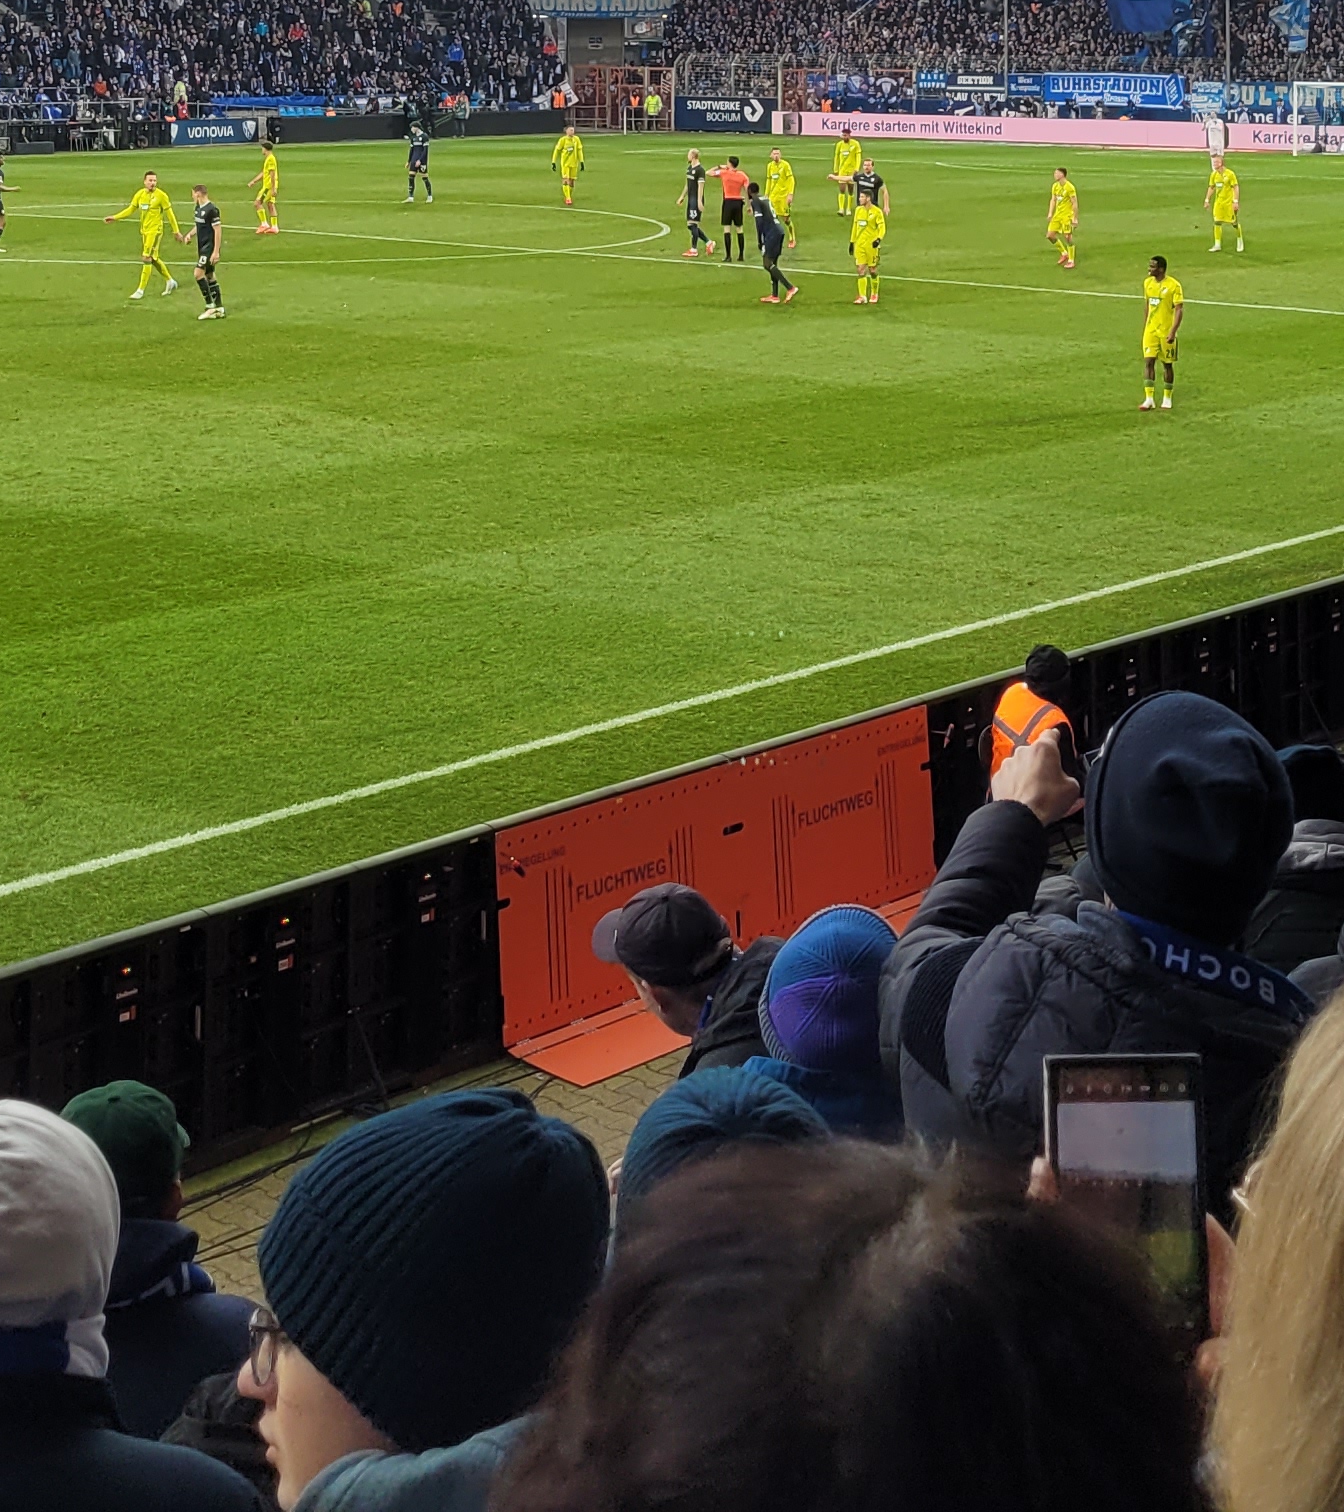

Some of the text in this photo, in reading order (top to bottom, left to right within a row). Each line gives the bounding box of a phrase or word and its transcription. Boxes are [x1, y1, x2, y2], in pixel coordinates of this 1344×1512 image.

[1050, 76, 1162, 95] RUHRSTADION
[686, 100, 741, 111] STADTWERKE
[706, 112, 741, 122] BOCHUM
[822, 118, 1002, 135] Karriere starten mit Wittekind
[797, 789, 874, 829] FLUCHTWEG
[576, 859, 667, 902] FLUCHTWEG
